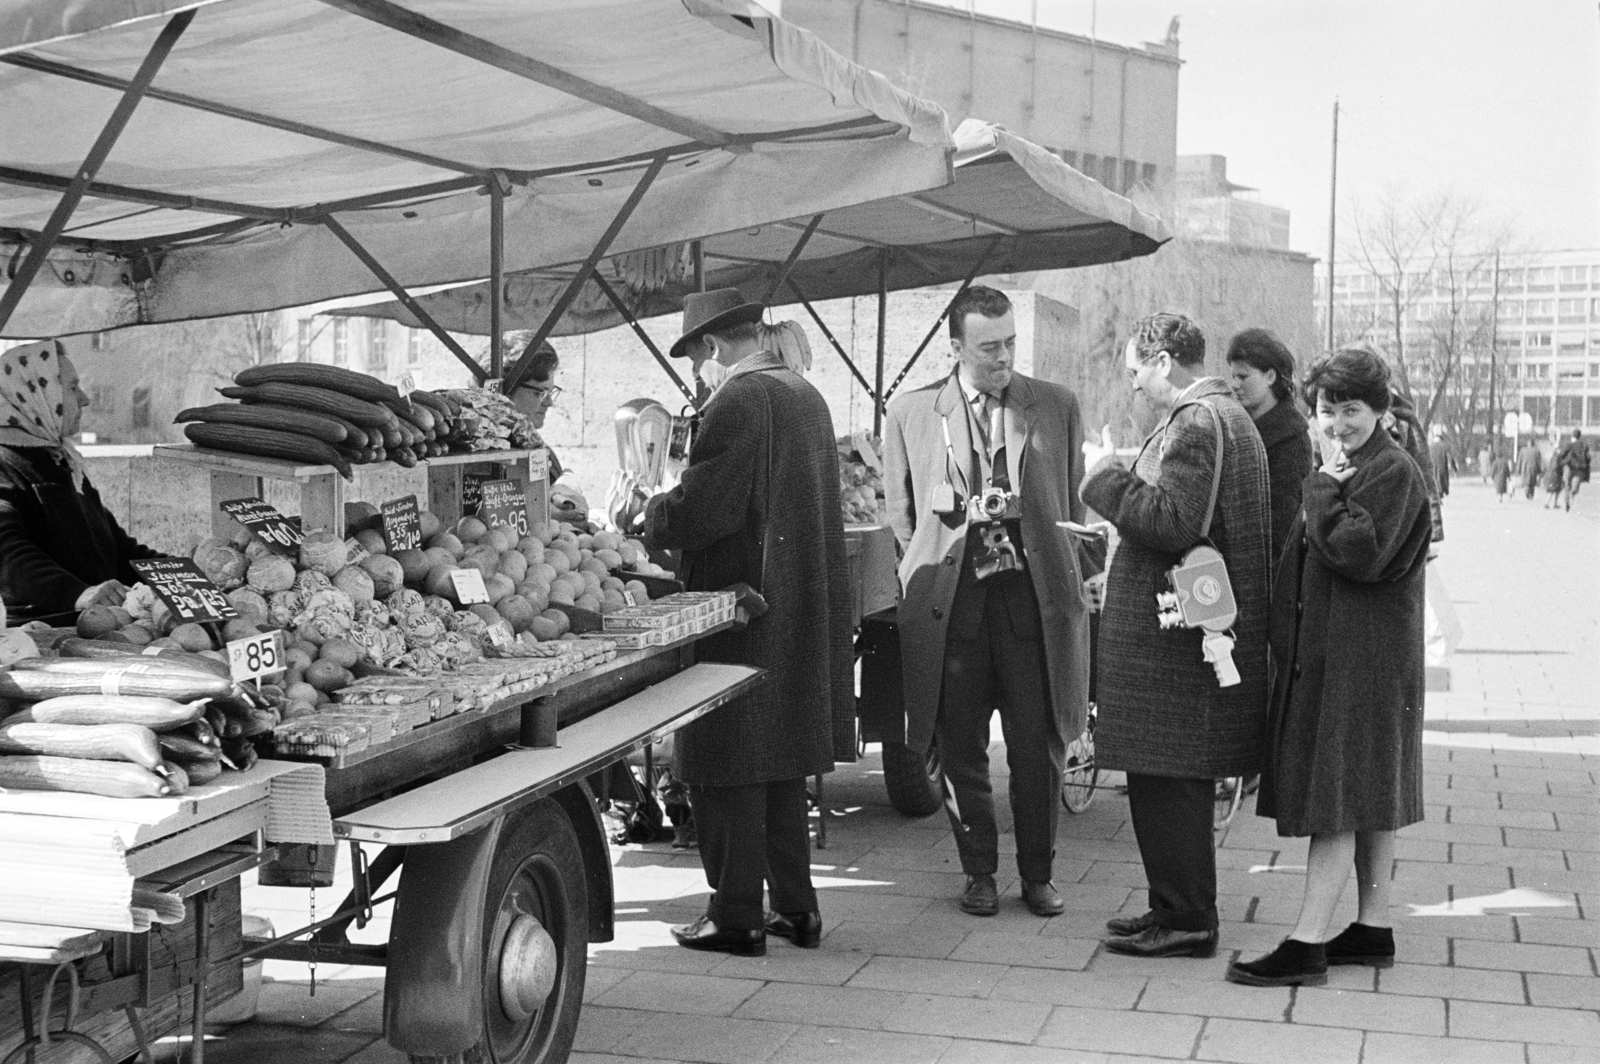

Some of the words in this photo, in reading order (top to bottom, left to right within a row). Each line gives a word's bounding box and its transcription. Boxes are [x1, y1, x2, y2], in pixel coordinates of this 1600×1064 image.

[487, 382, 498, 394] 45
[265, 523, 302, 546] 60
[147, 572, 200, 584] Stayman
[246, 637, 276, 673] 85
